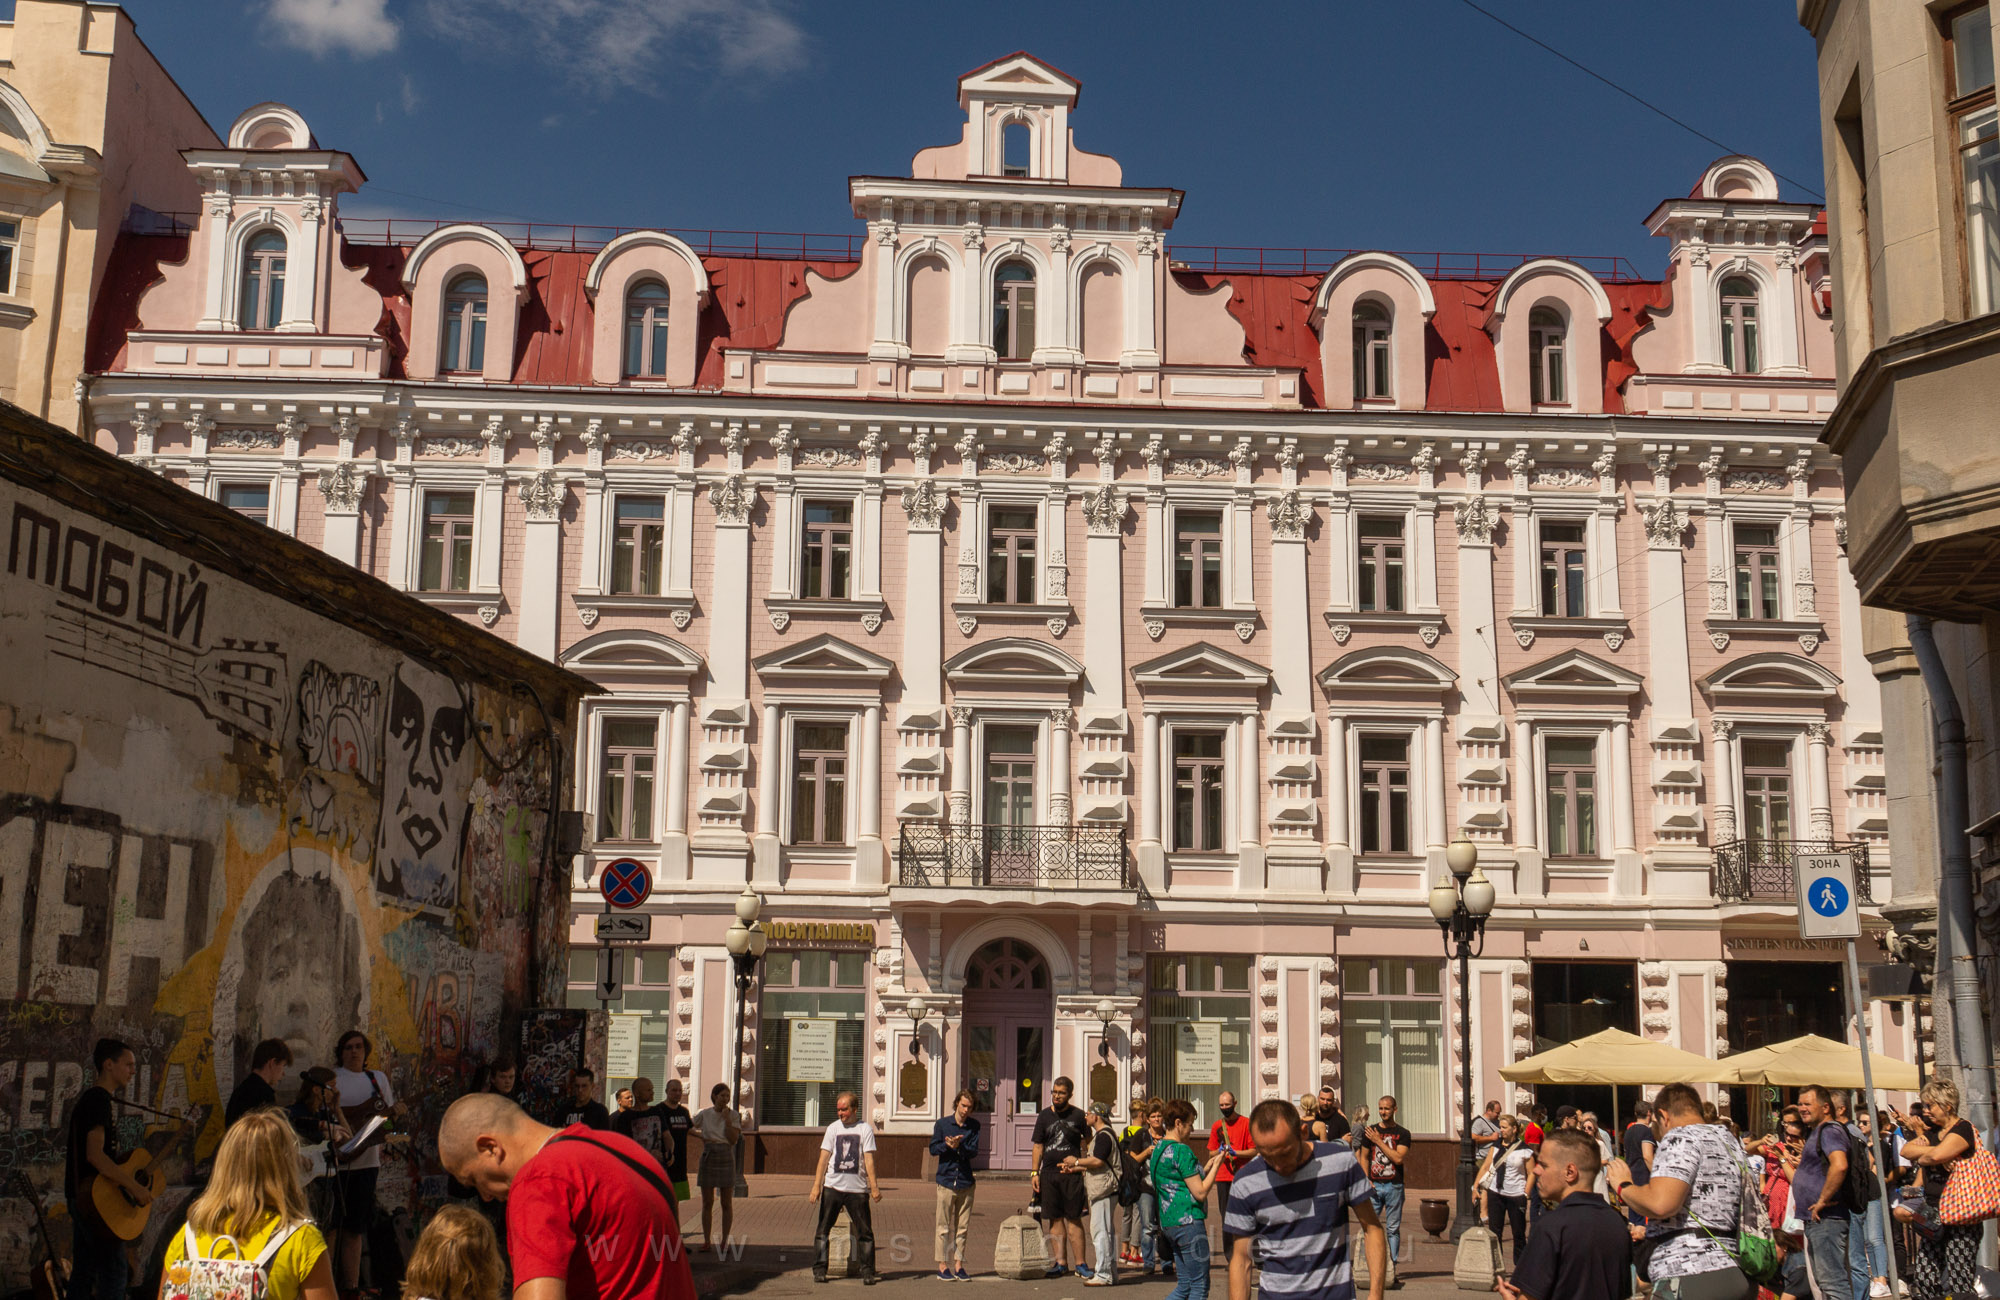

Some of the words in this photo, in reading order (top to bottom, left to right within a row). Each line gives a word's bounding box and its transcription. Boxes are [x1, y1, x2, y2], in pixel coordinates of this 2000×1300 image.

[1809, 859, 1841, 869] ЗОНА
[760, 921, 874, 943] МОСИТАЛМЕД
[1726, 938, 1782, 951] SIXTEEN
[1783, 939, 1818, 951] TONS
